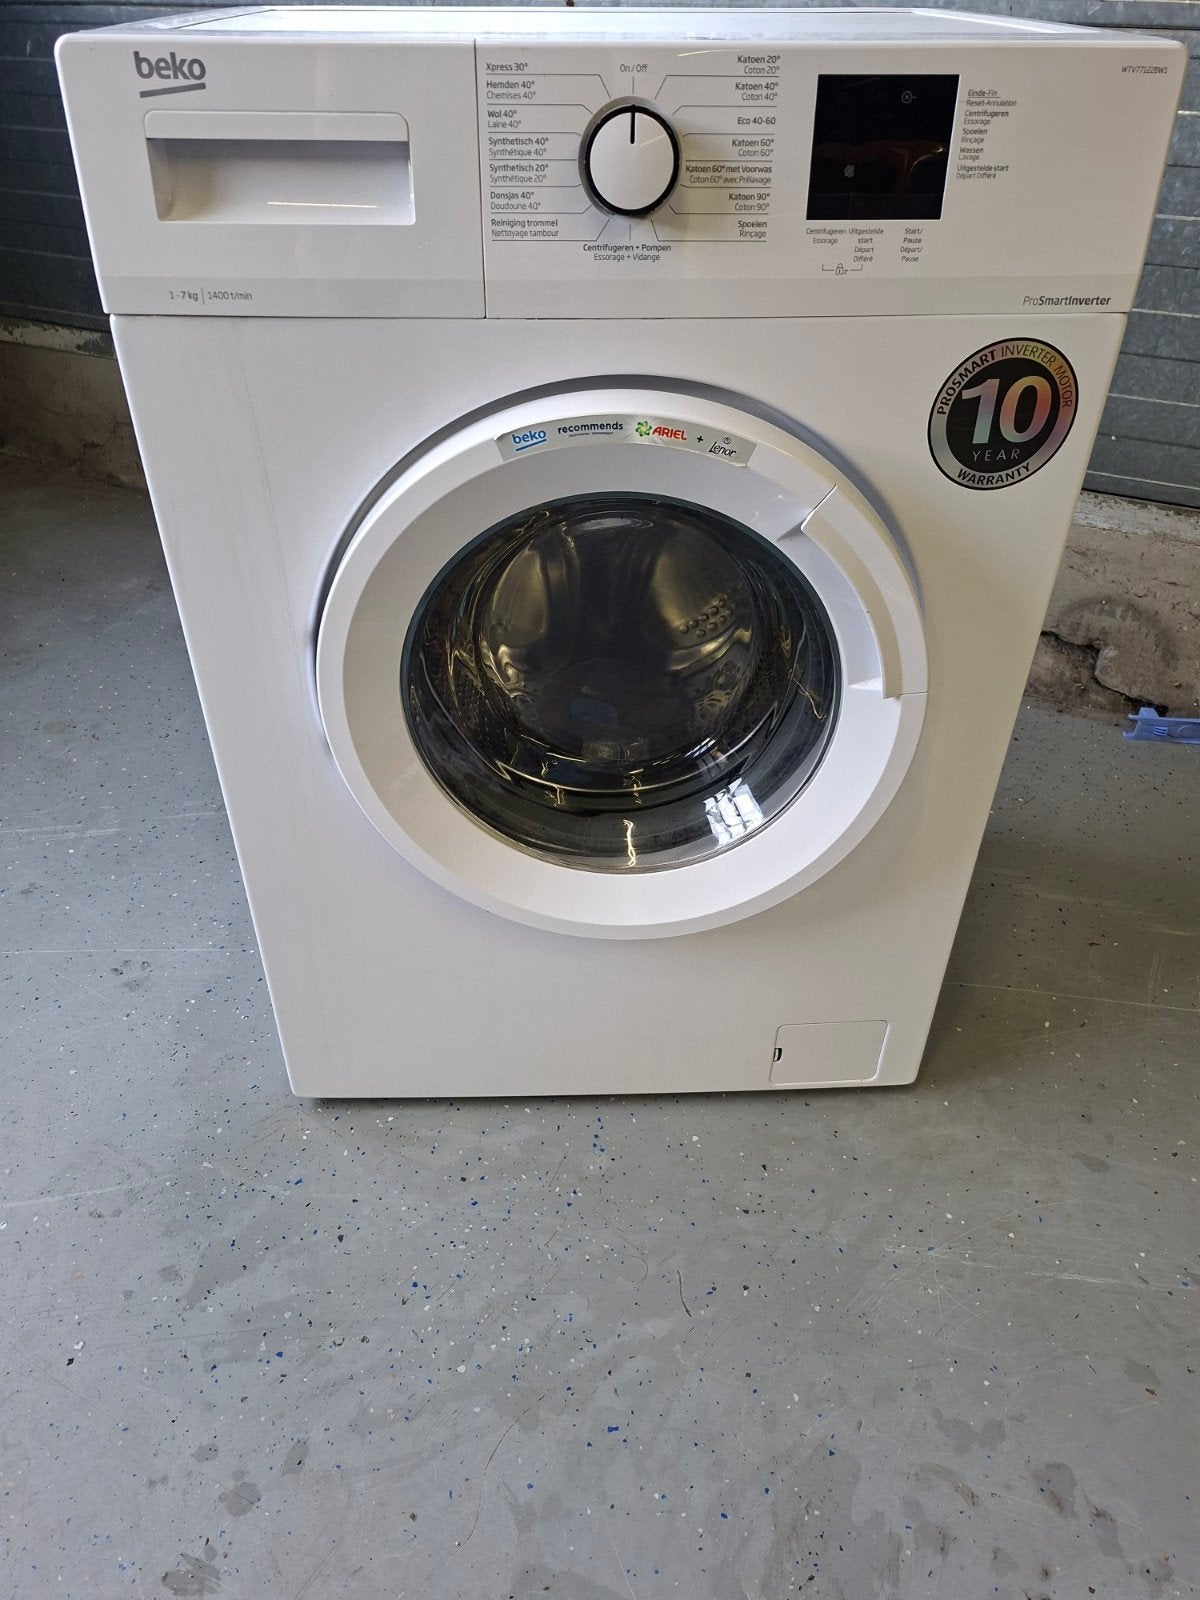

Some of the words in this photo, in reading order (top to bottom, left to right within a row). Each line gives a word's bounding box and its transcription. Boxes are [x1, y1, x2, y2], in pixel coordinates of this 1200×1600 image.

[737, 55, 765, 63] Katoen
[133, 51, 206, 80] beko
[486, 63, 512, 71] Xpress
[620, 64, 630, 72] On
[636, 64, 647, 72] Off
[744, 66, 764, 74] Coton
[486, 81, 519, 89] Hemden
[735, 82, 762, 90] Katoen
[486, 91, 521, 99] Chemises
[488, 120, 506, 128] Laine
[752, 116, 776, 124] 40-60
[488, 137, 533, 147] Synthetisch
[732, 139, 759, 147] Katoen
[489, 148, 532, 157] Synthétique
[738, 149, 759, 157] Coton
[489, 164, 534, 173] Synthetisch
[685, 165, 711, 173] Katoen
[741, 165, 772, 173] Voorwas
[490, 175, 533, 184] Synthétique
[689, 175, 709, 183] Coton
[490, 191, 519, 201] Donsjas
[490, 202, 527, 210] Doudoune
[734, 203, 755, 211] Coton
[491, 219, 526, 228] Reiniging
[527, 219, 558, 227] trommel
[738, 220, 767, 229] Spoelen
[491, 229, 528, 238] Nettoyage
[530, 229, 559, 237] tambour
[739, 230, 767, 239] Rinçage
[583, 244, 634, 253] Centrifugeren
[641, 244, 671, 252] Pompen
[594, 253, 625, 262] Essorage
[632, 253, 660, 262] Vidange
[207, 291, 229, 299] 1400
[230, 291, 253, 300] t/min
[1022, 296, 1111, 305] ProSmartInverter
[937, 349, 997, 415] PROSMART
[1001, 344, 1057, 365] INVERTER
[1053, 365, 1073, 408] MOTOR
[961, 375, 1052, 444] 10
[558, 421, 624, 434] recommends
[512, 429, 547, 445] beko
[652, 426, 687, 441] ARIEL
[709, 441, 737, 457] Lenor
[972, 448, 1020, 462] YEAR
[957, 462, 1031, 485] WARRANTY
